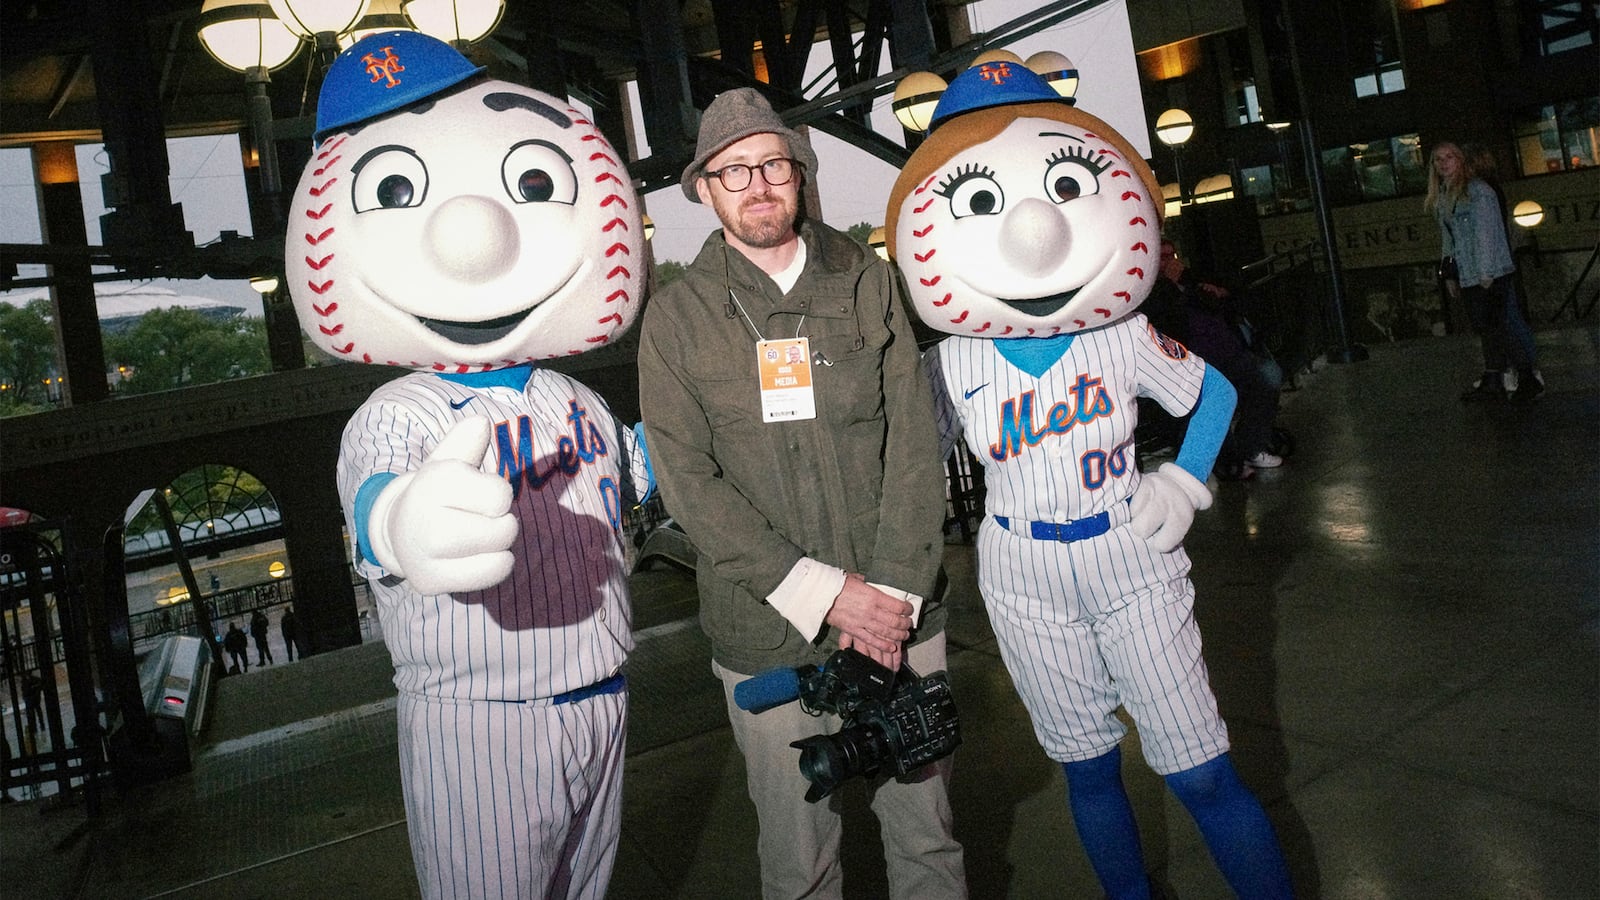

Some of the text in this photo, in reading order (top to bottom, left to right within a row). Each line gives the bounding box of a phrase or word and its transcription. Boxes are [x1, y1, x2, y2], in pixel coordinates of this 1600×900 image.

[359, 46, 406, 88] NY
[979, 63, 1013, 86] NY
[774, 376, 798, 387] MEDIA
[989, 373, 1116, 462] Mets
[494, 399, 610, 503] Mets
[1080, 447, 1127, 492] 00
[924, 684, 942, 694] SONY
